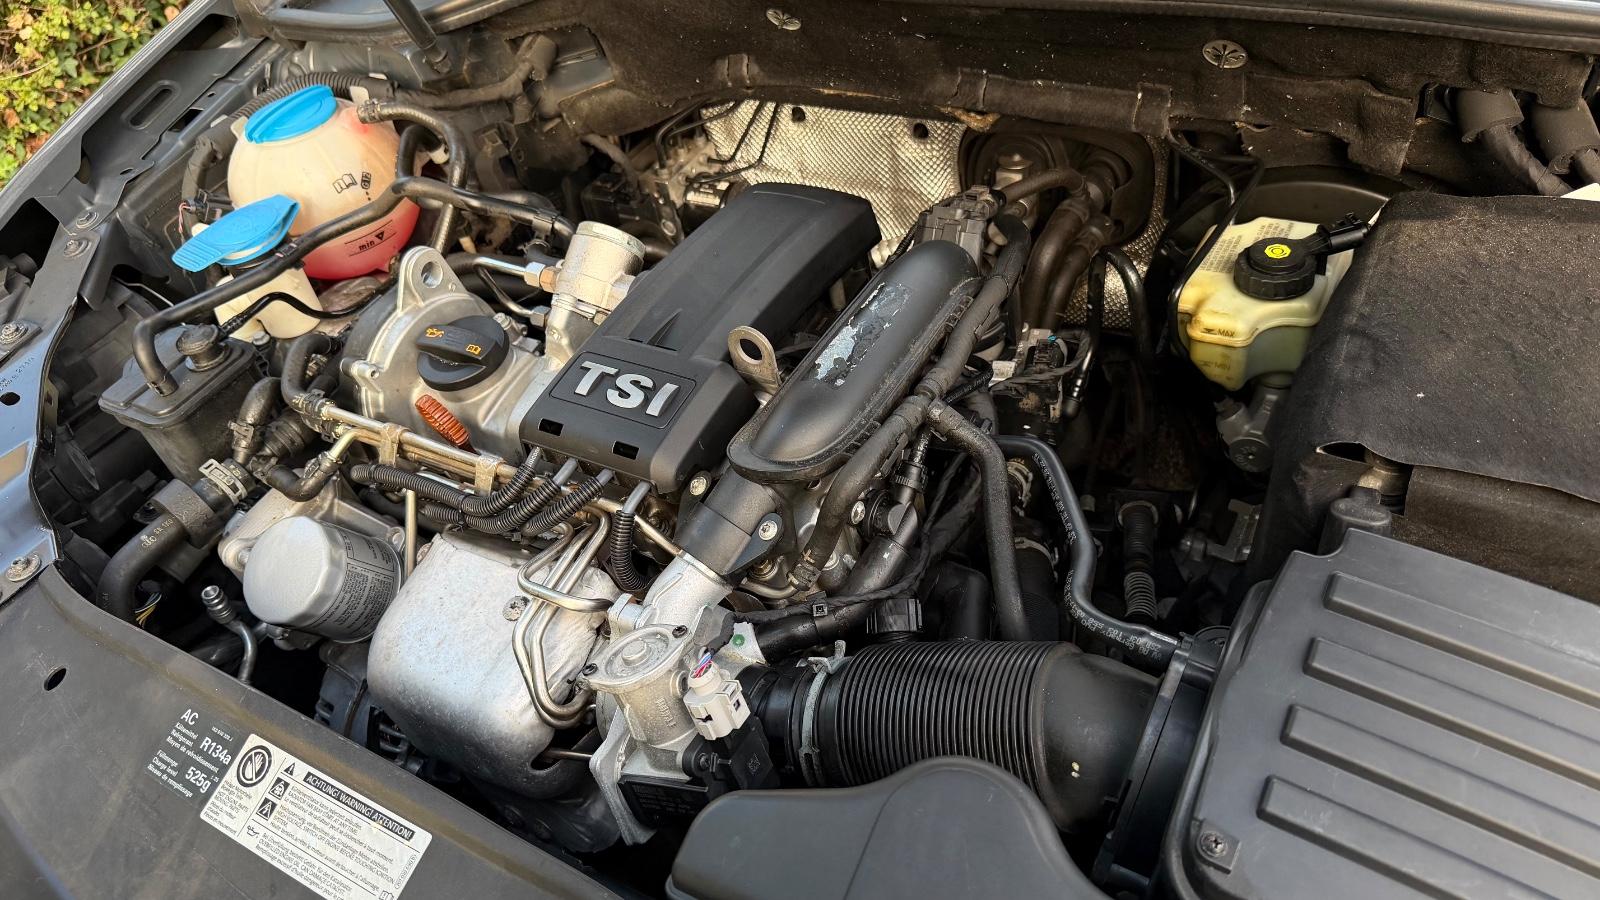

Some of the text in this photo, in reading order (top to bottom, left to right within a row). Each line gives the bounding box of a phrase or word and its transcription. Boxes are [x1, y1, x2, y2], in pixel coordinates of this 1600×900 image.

[357, 238, 375, 250] min
[1217, 328, 1235, 336] MAX
[571, 360, 681, 418] TSI
[181, 709, 198, 725] AC
[166, 736, 180, 748] Moyen
[200, 737, 231, 765] R134a
[186, 766, 212, 793] 525g
[306, 775, 412, 839] ACHTUNG! WARNING! ATTENTION!
